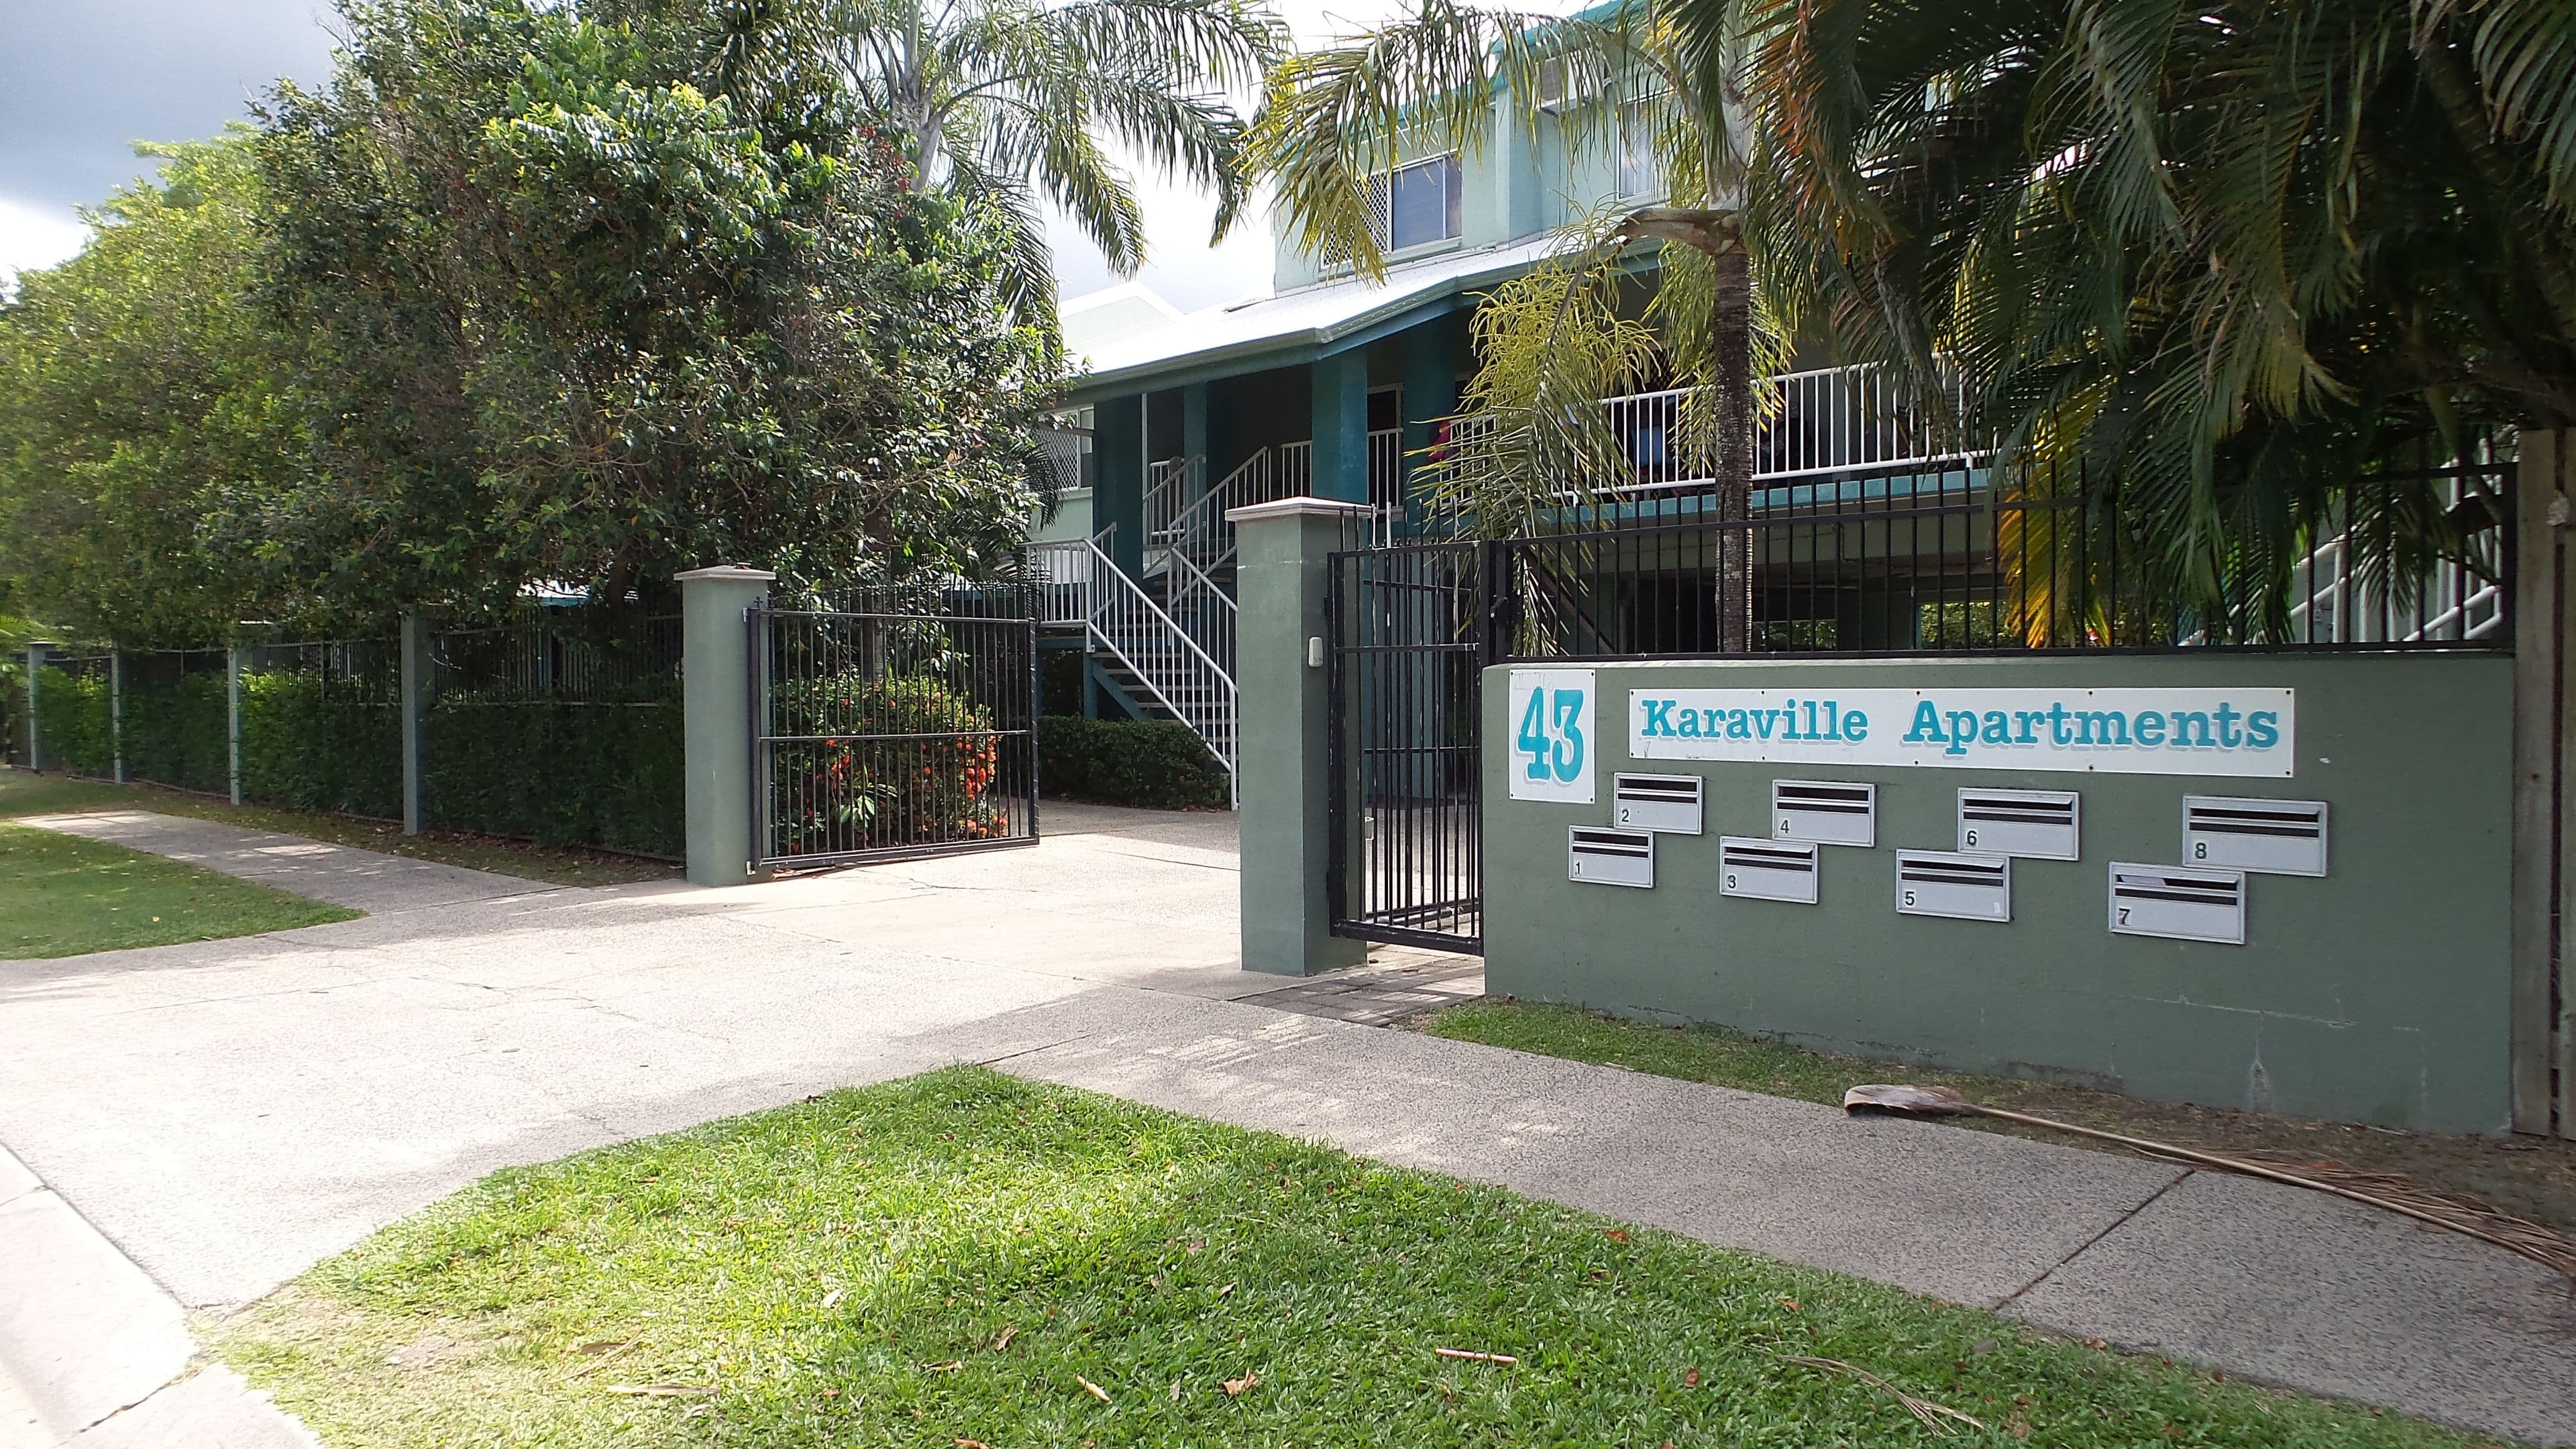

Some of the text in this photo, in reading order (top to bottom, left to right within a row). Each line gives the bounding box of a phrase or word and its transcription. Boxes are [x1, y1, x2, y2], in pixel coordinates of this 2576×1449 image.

[1517, 686, 1584, 783] 43
[1641, 698, 2279, 756] Karaville Apartments
[1621, 809, 1629, 822] 2
[1780, 819, 1790, 834] 4
[1966, 830, 1978, 846] 6
[2194, 842, 2207, 859] 8
[1727, 875, 1737, 889] 3
[1904, 890, 1915, 906] 5
[2118, 907, 2131, 925] 7
